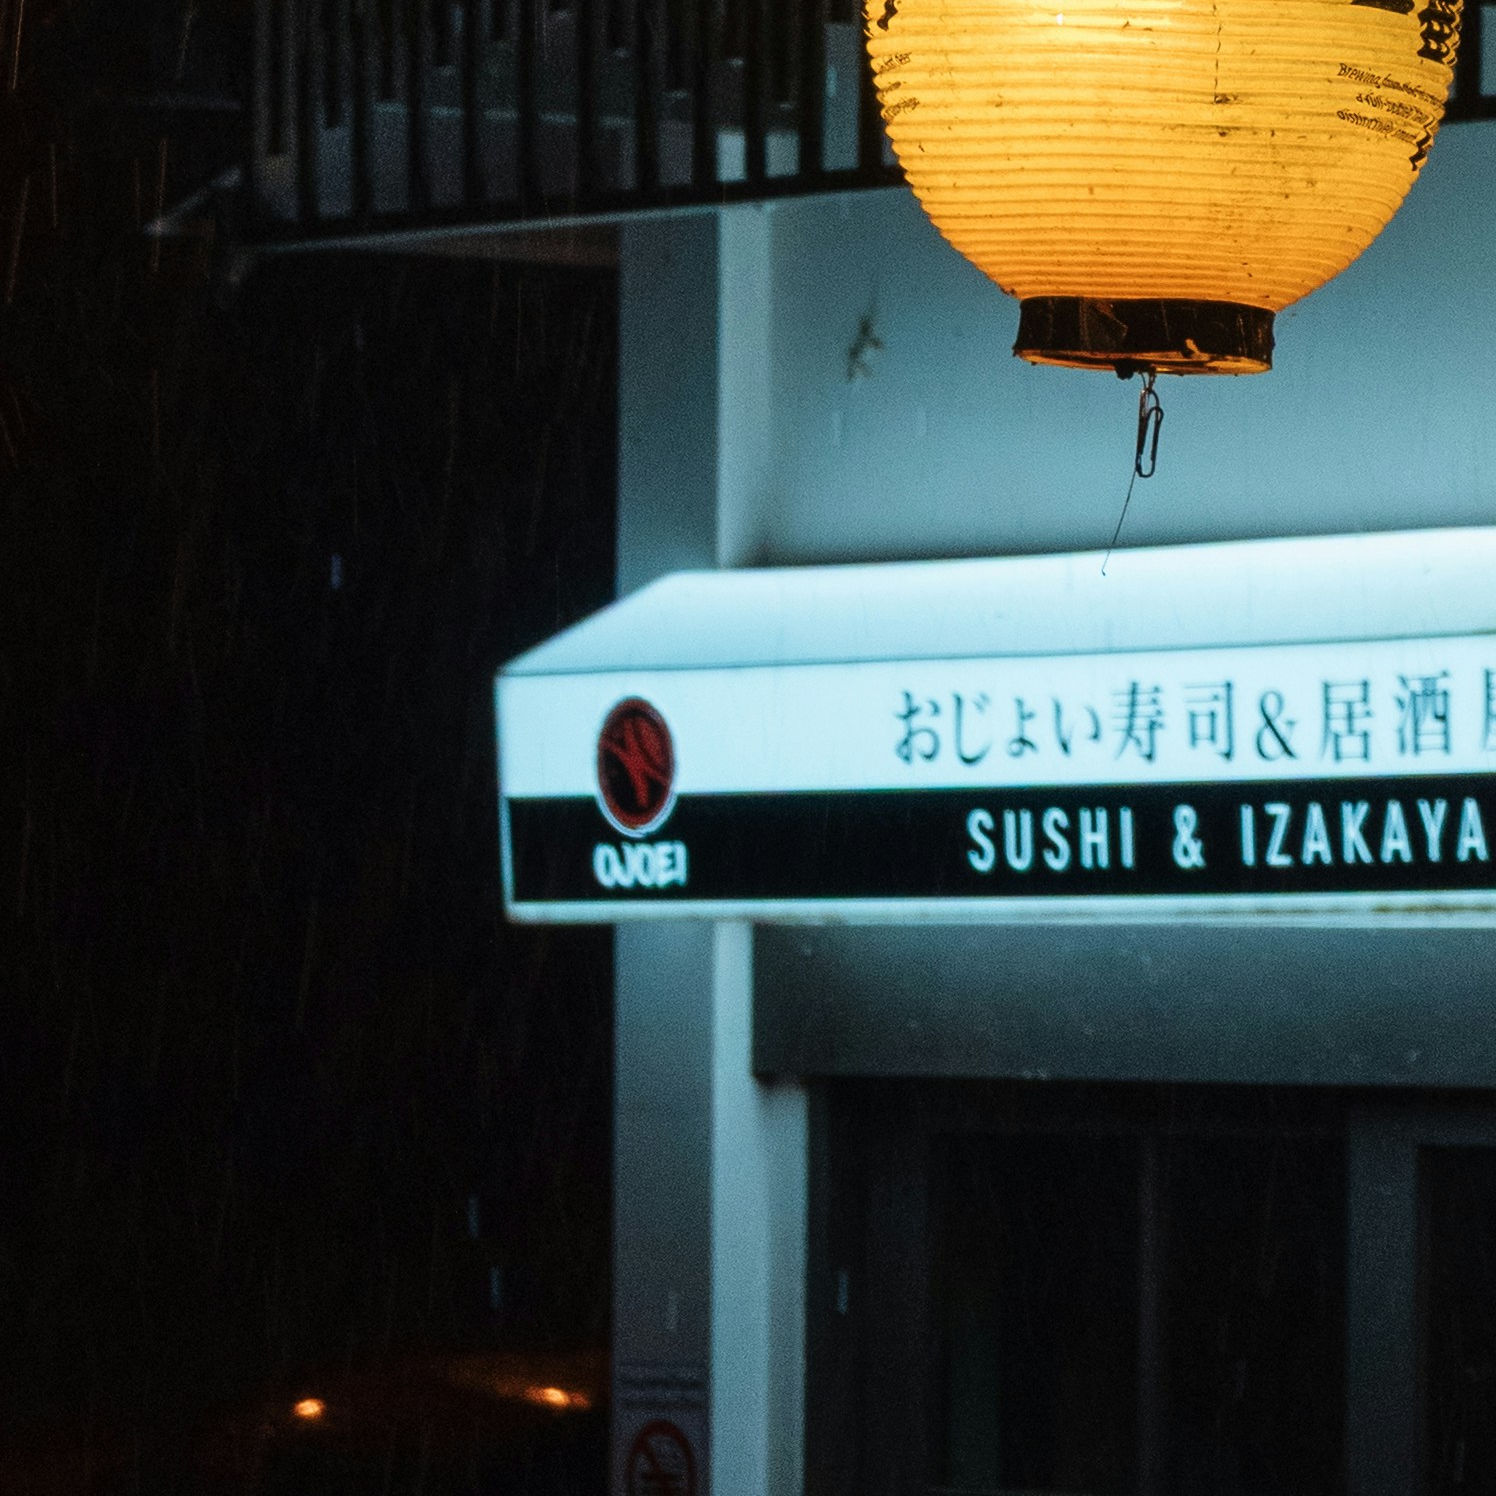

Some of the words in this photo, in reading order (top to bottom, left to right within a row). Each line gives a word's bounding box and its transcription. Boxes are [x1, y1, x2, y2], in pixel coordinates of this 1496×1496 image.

[1337, 62, 1381, 89] Brewing
[966, 805, 1137, 873] SUSHI
[1171, 804, 1206, 871] &
[1238, 796, 1490, 870] IZAKAYA
